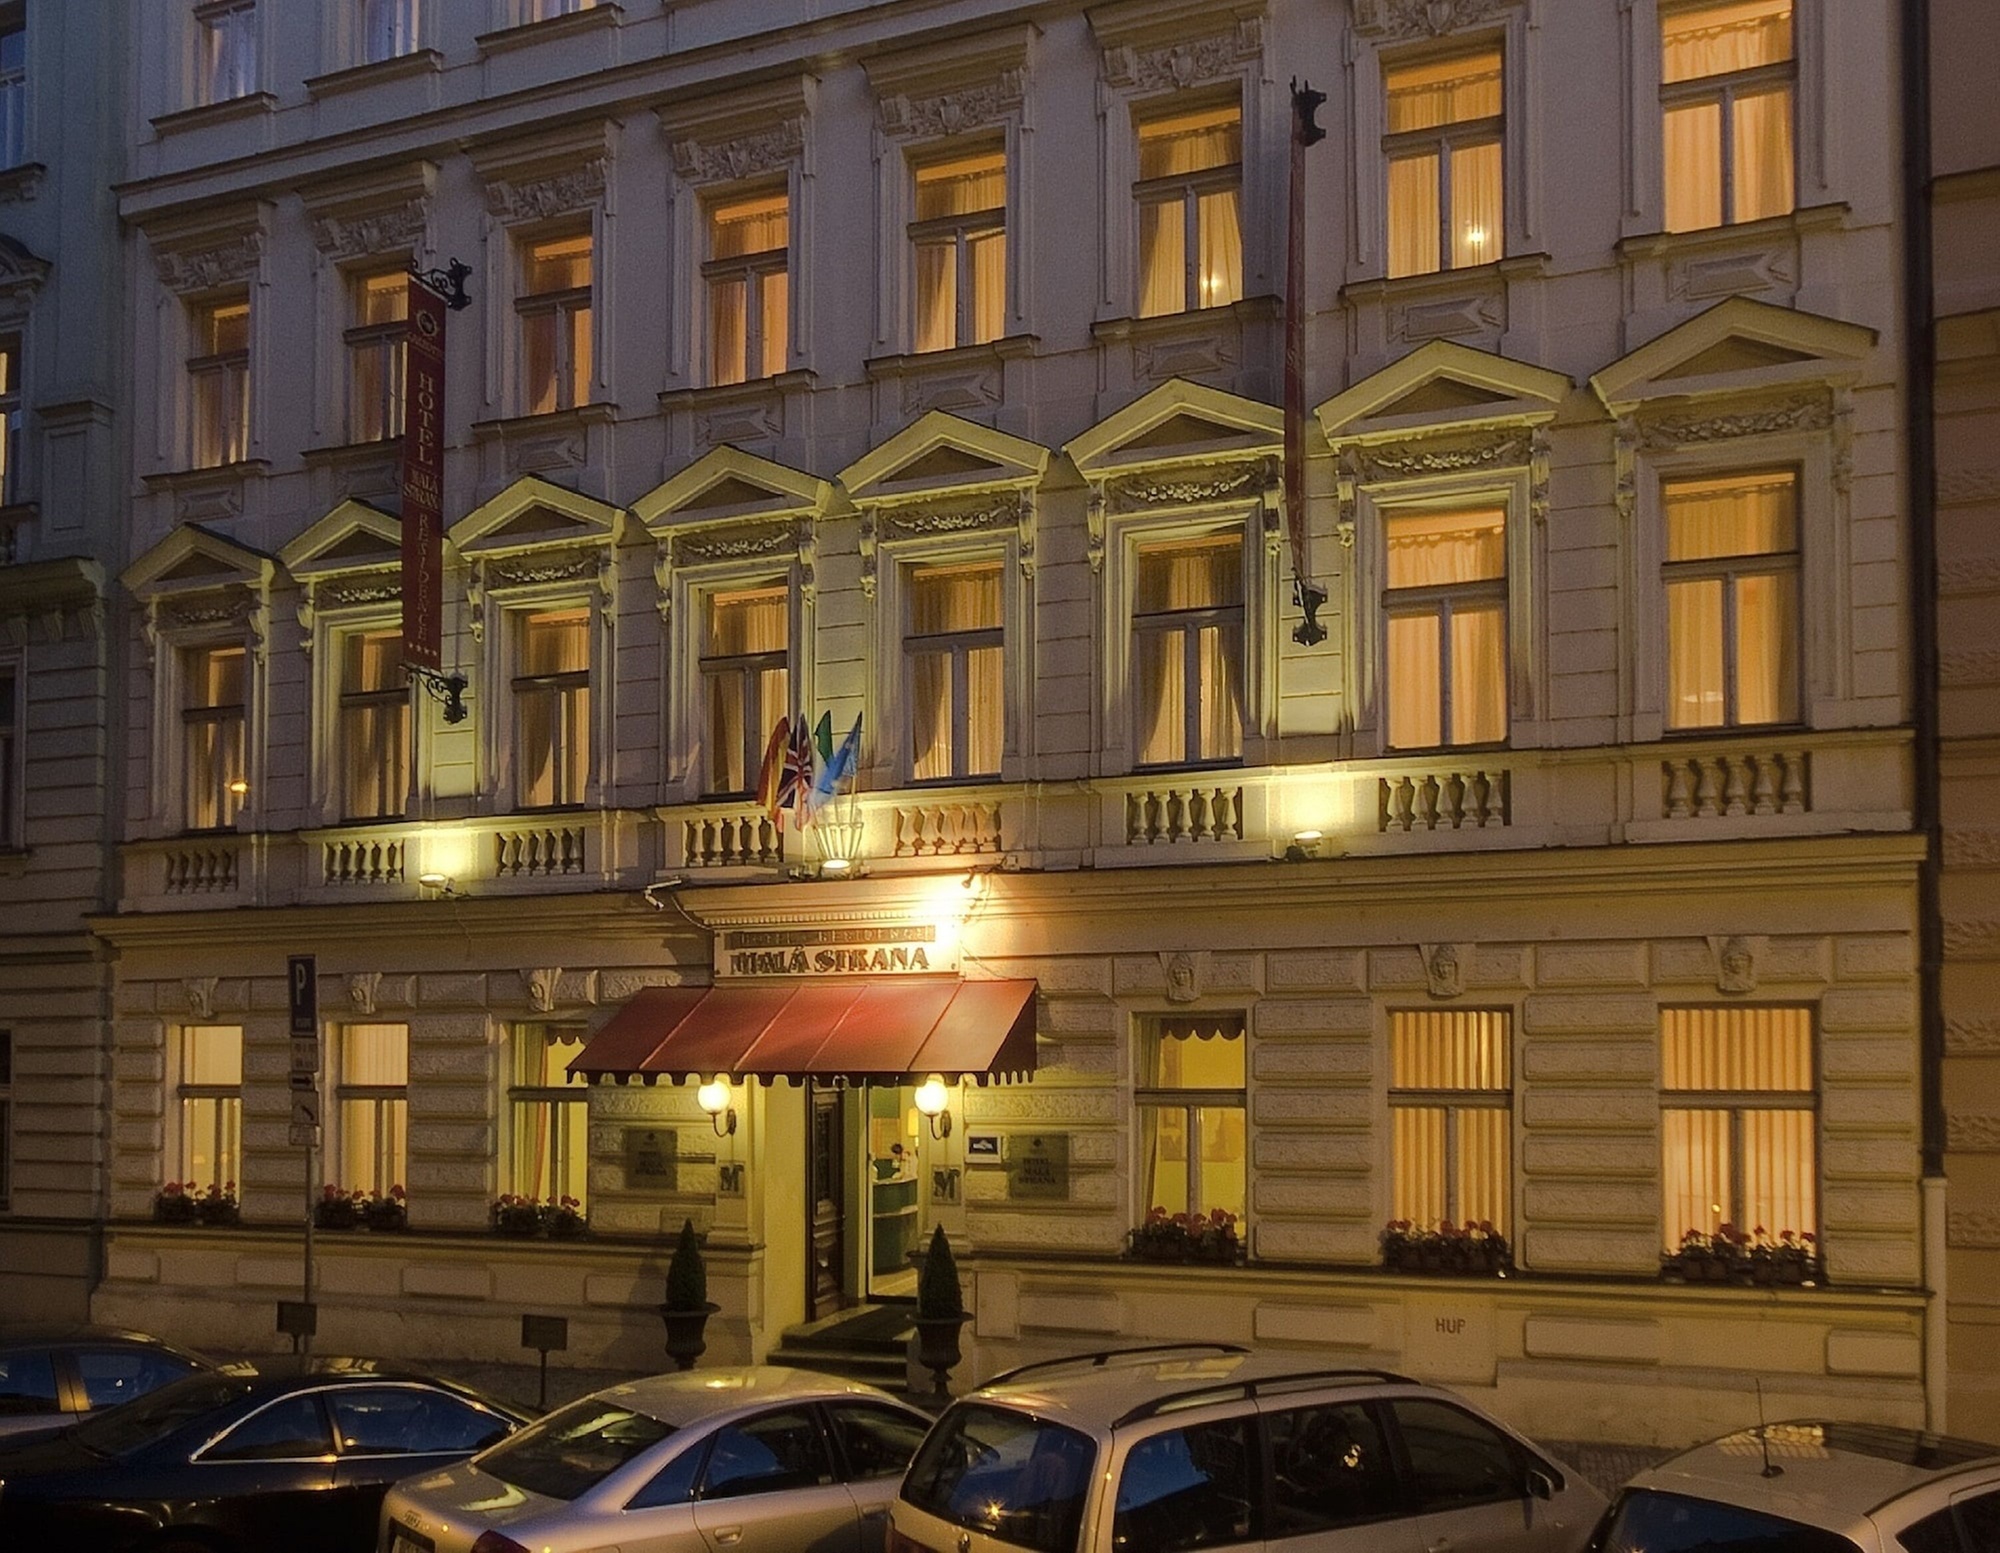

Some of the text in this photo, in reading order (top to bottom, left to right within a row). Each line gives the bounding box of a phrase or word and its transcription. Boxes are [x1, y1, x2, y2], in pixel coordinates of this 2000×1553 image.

[418, 372, 439, 466] HOTEL
[417, 513, 430, 641] RESIDENCE
[730, 945, 930, 974] MALÁ STRANA
[295, 963, 307, 1006] P
[1435, 1317, 1466, 1334] HUP
